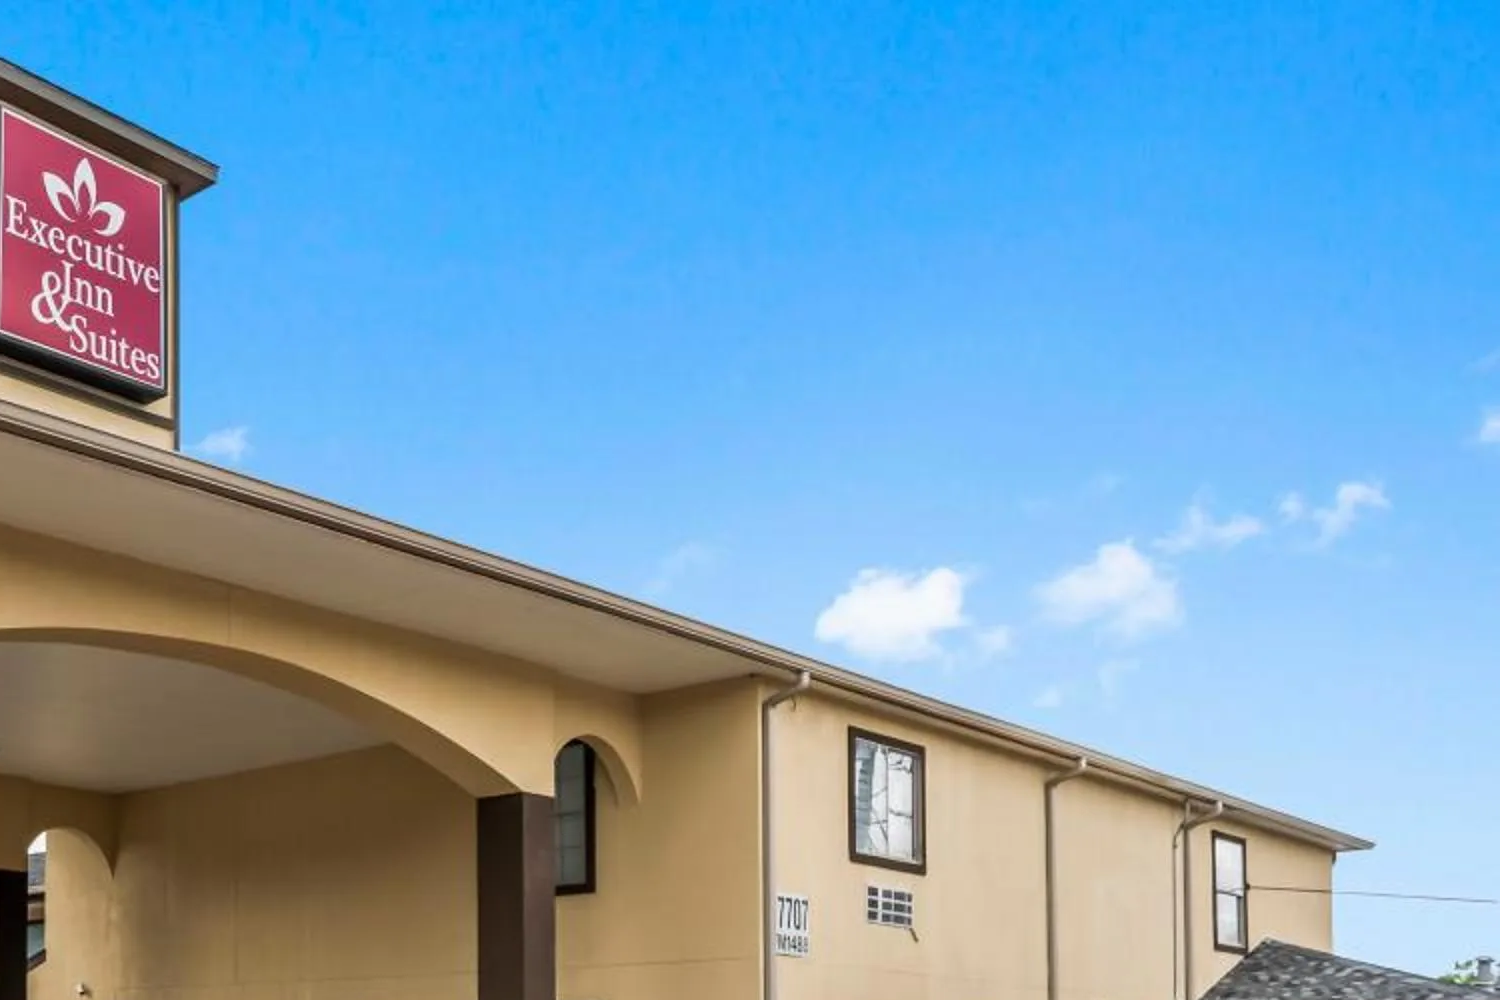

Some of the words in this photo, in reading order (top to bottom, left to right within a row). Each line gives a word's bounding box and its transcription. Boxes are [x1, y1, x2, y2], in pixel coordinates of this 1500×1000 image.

[5, 195, 160, 293] Executive
[31, 271, 73, 332] &
[69, 314, 160, 379] Suites
[61, 259, 115, 317] Inn
[777, 896, 809, 931] 7707
